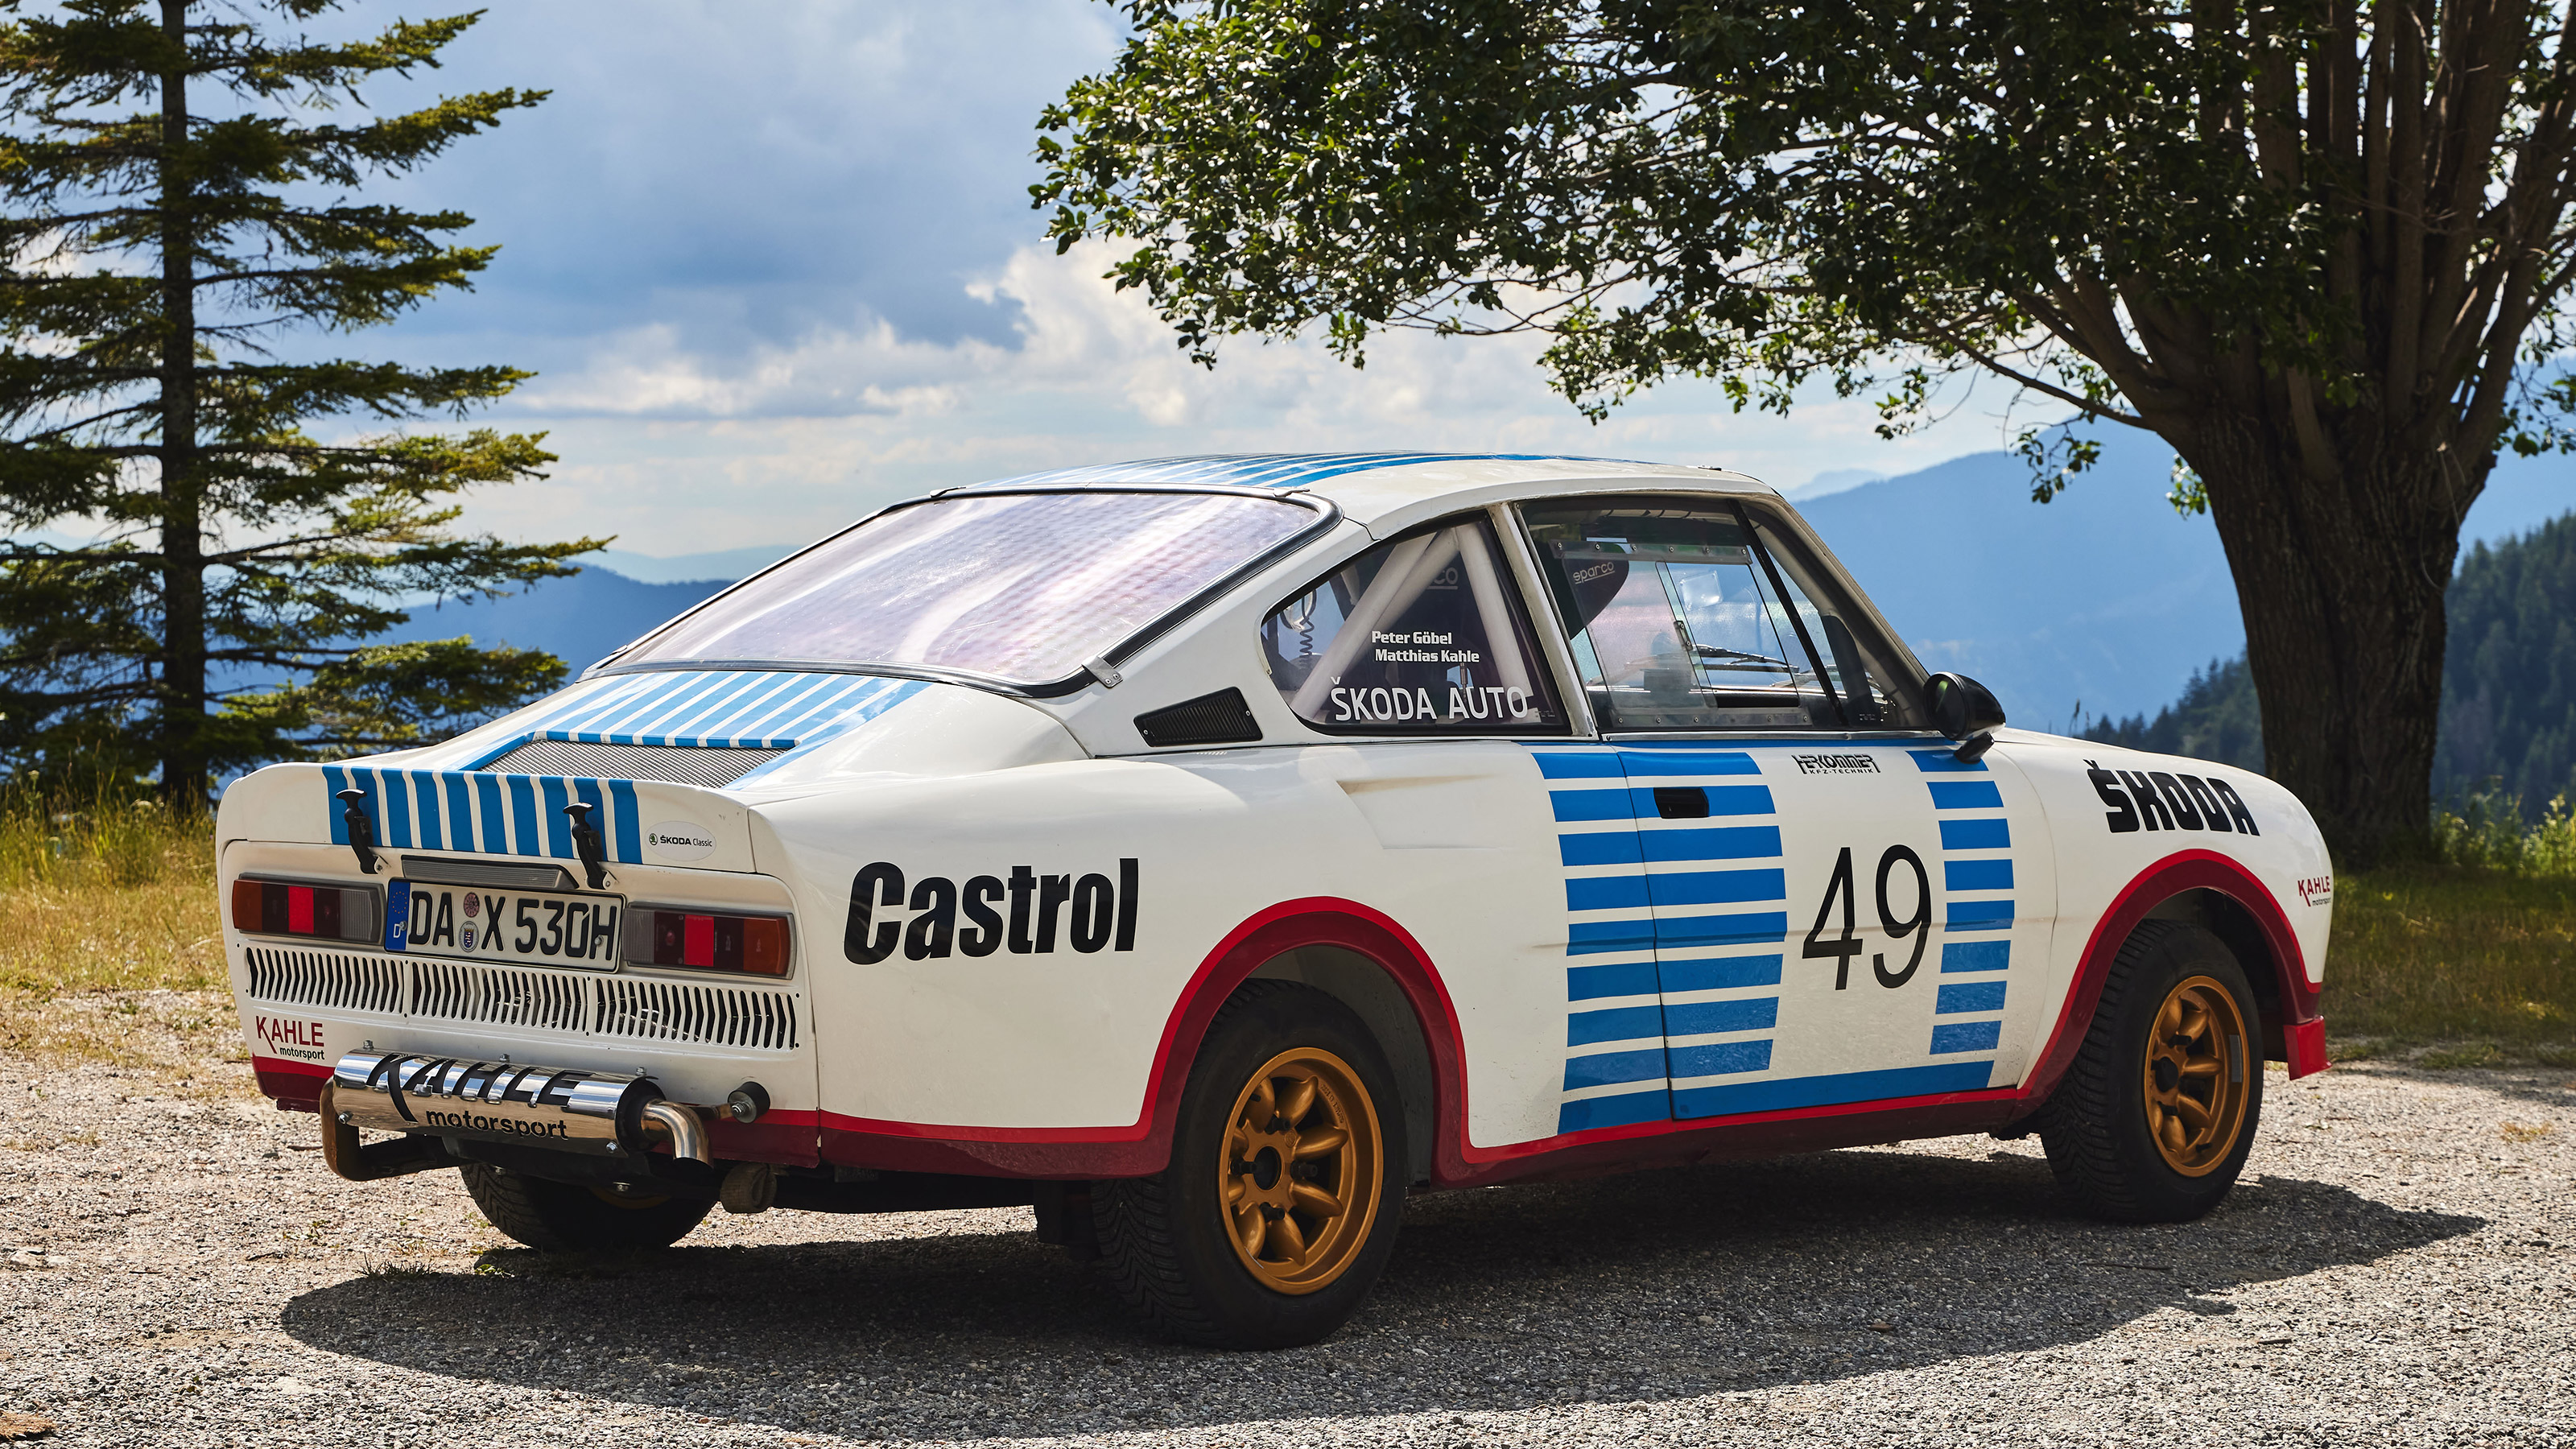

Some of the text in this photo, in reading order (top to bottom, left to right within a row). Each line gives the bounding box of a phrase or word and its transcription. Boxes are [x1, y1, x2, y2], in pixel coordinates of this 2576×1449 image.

[1571, 562, 1615, 584] sparco
[1371, 630, 1452, 645] Peter Göbel
[1375, 648, 1480, 663] Matthias Kahle
[1330, 676, 1529, 721] ŠKODA AUTO
[2083, 758, 2260, 836] ŠKODA
[660, 835, 712, 848] ŠKODA Classic
[2297, 876, 2330, 907] KAHLE
[408, 890, 617, 961] DA X 530H
[844, 858, 1139, 965] Castrol
[1802, 844, 1932, 990] 49
[393, 923, 402, 939] D
[256, 1016, 324, 1054] KAHLE
[279, 1046, 325, 1060] motorsport
[365, 1052, 594, 1123] KAHLE
[425, 1109, 568, 1141] motorsport
